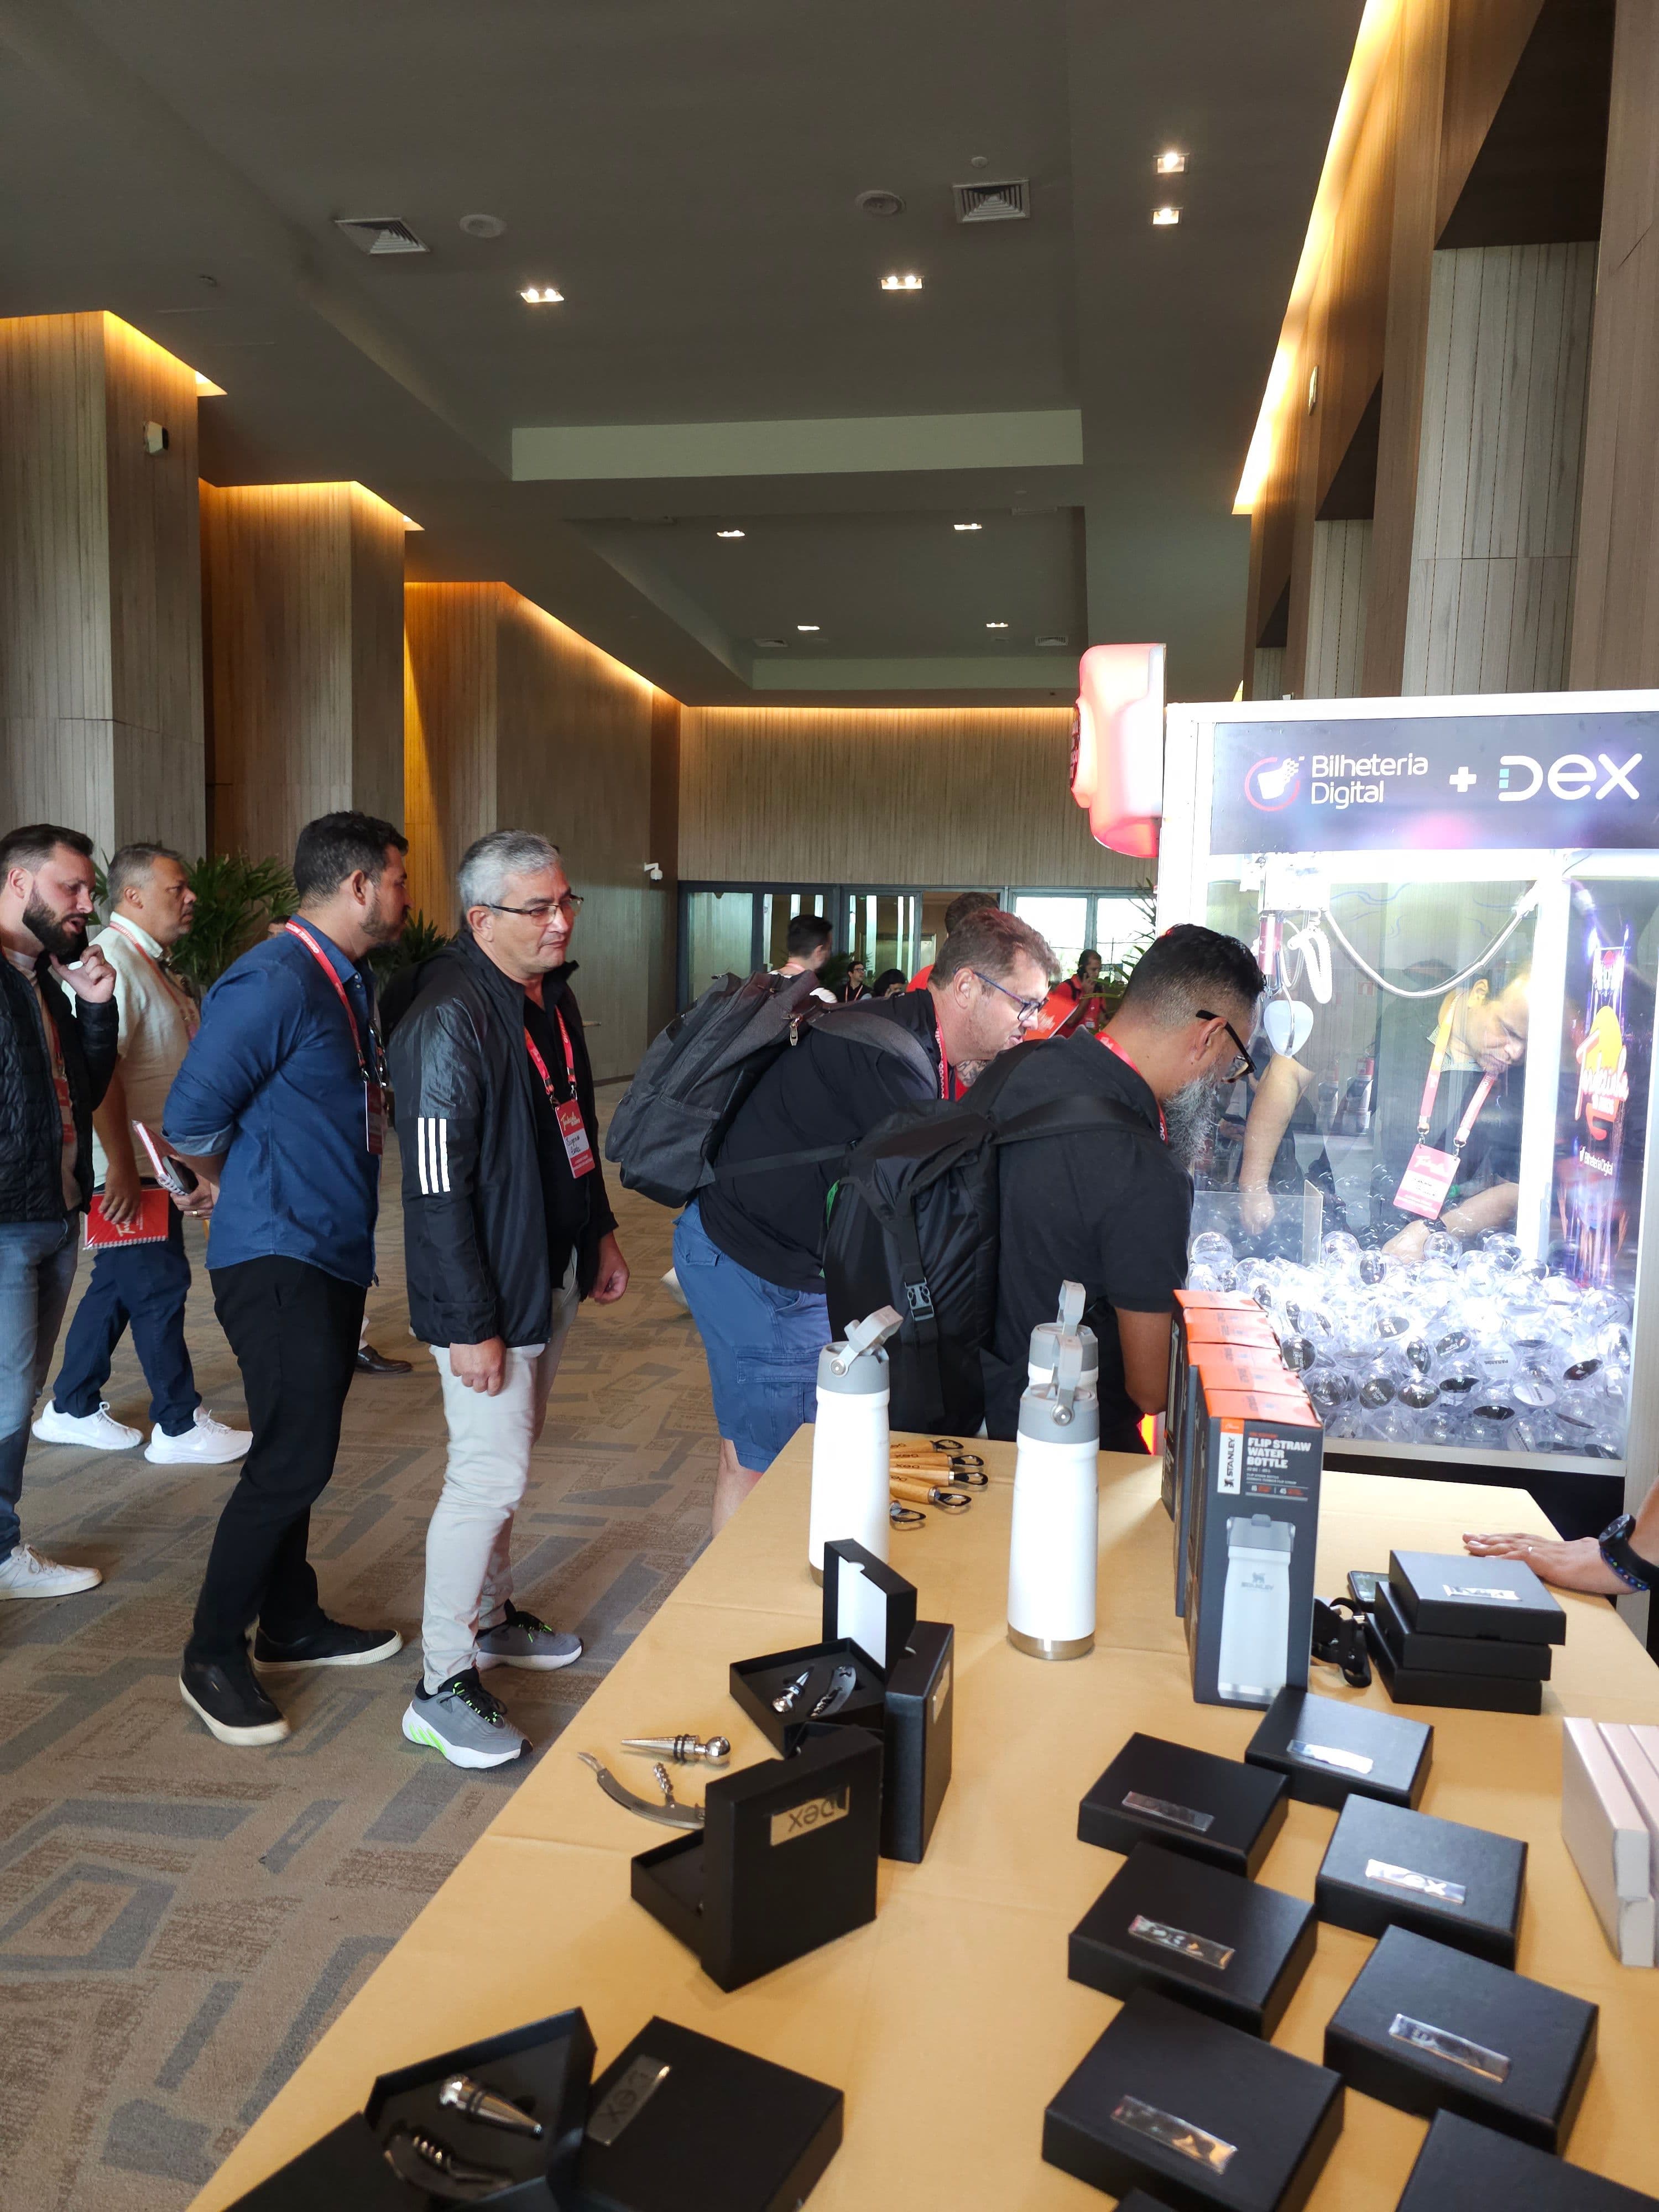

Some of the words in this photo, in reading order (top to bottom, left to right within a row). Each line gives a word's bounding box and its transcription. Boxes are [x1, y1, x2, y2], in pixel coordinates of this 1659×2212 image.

[1312, 753, 1428, 778] Bilheteria
[1311, 780, 1384, 810] Digital
[1247, 1447, 1285, 1459] WATER
[1248, 1437, 1272, 1448] FLIP
[1273, 1439, 1312, 1452] STRAW
[1227, 1437, 1235, 1477] STANLEY
[1246, 1456, 1288, 1469] BOTTLE
